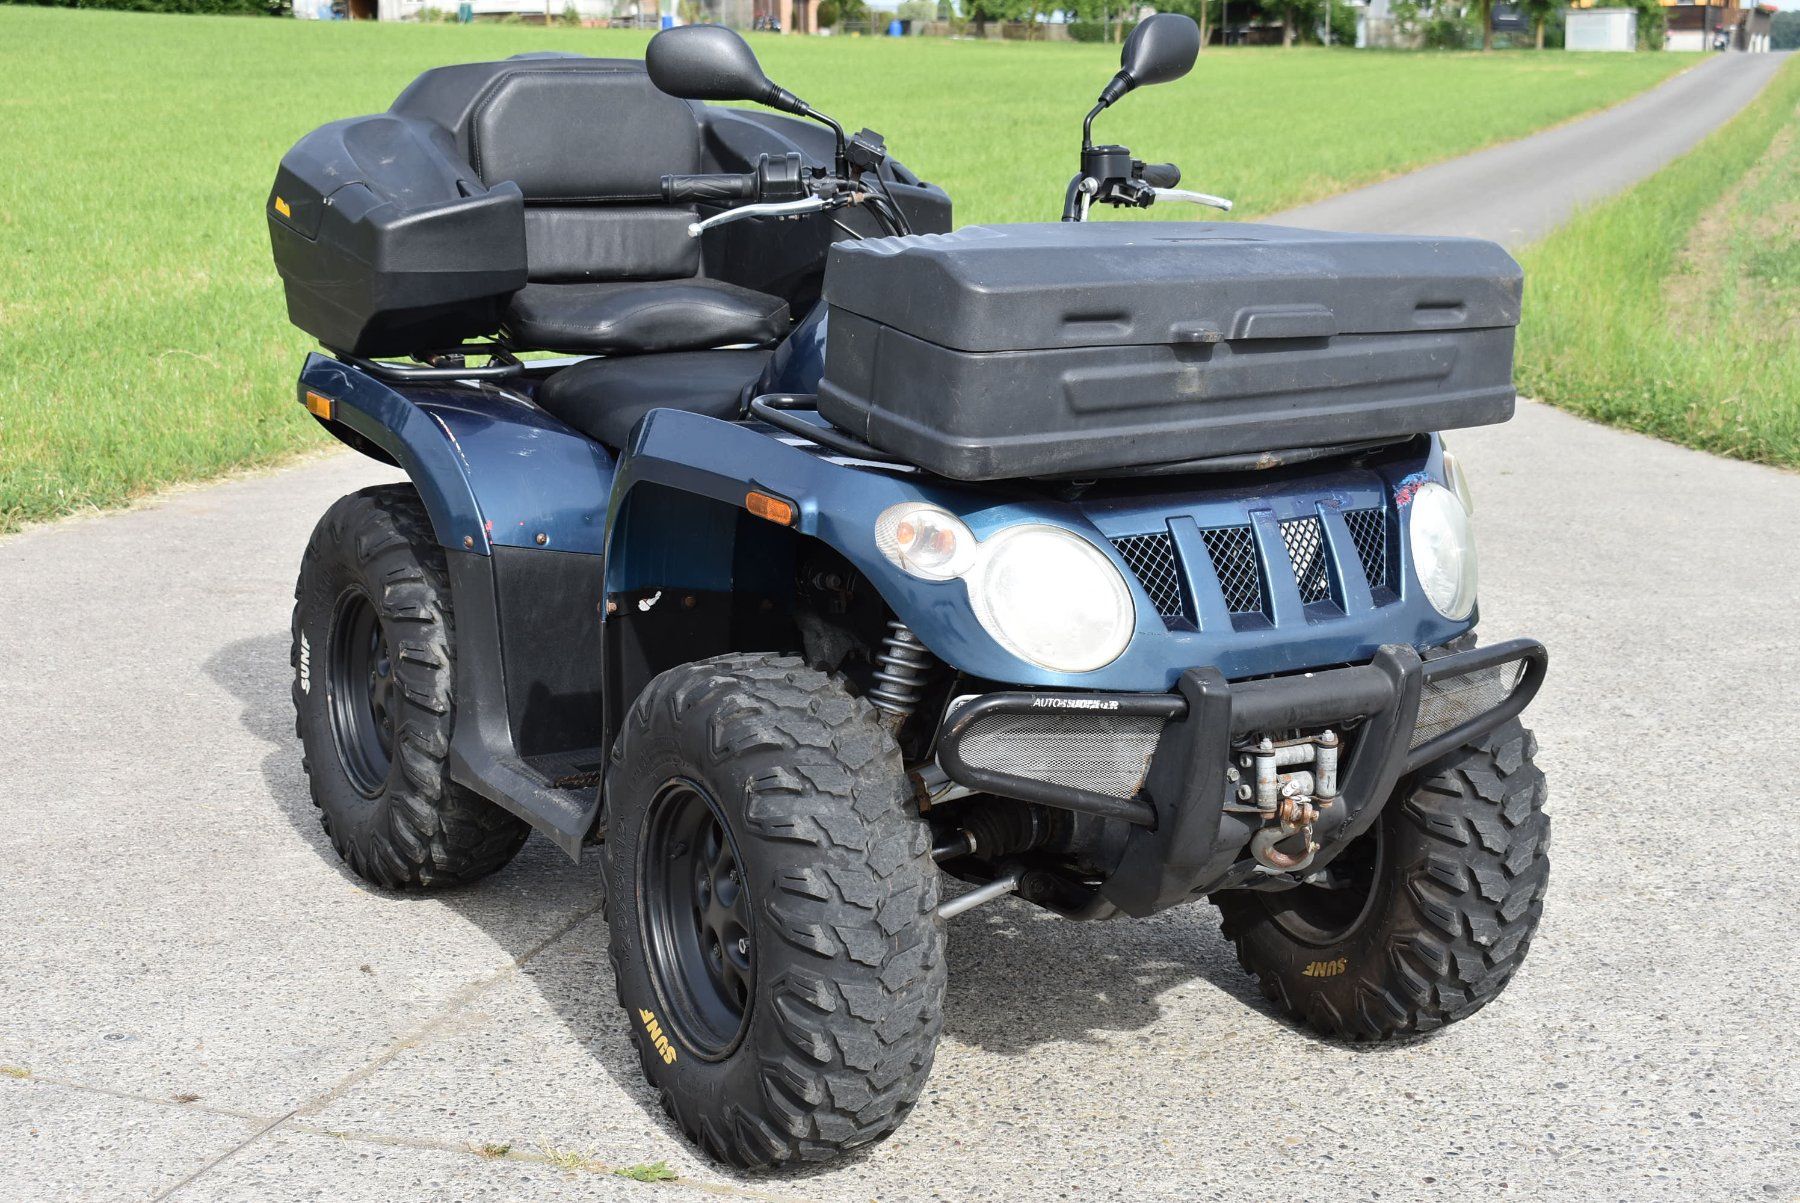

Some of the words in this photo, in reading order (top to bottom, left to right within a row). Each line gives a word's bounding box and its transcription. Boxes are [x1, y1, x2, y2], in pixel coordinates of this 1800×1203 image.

[301, 629, 311, 695] SUNF
[1301, 957, 1347, 977] SUNF
[639, 1008, 677, 1065] SUNF
